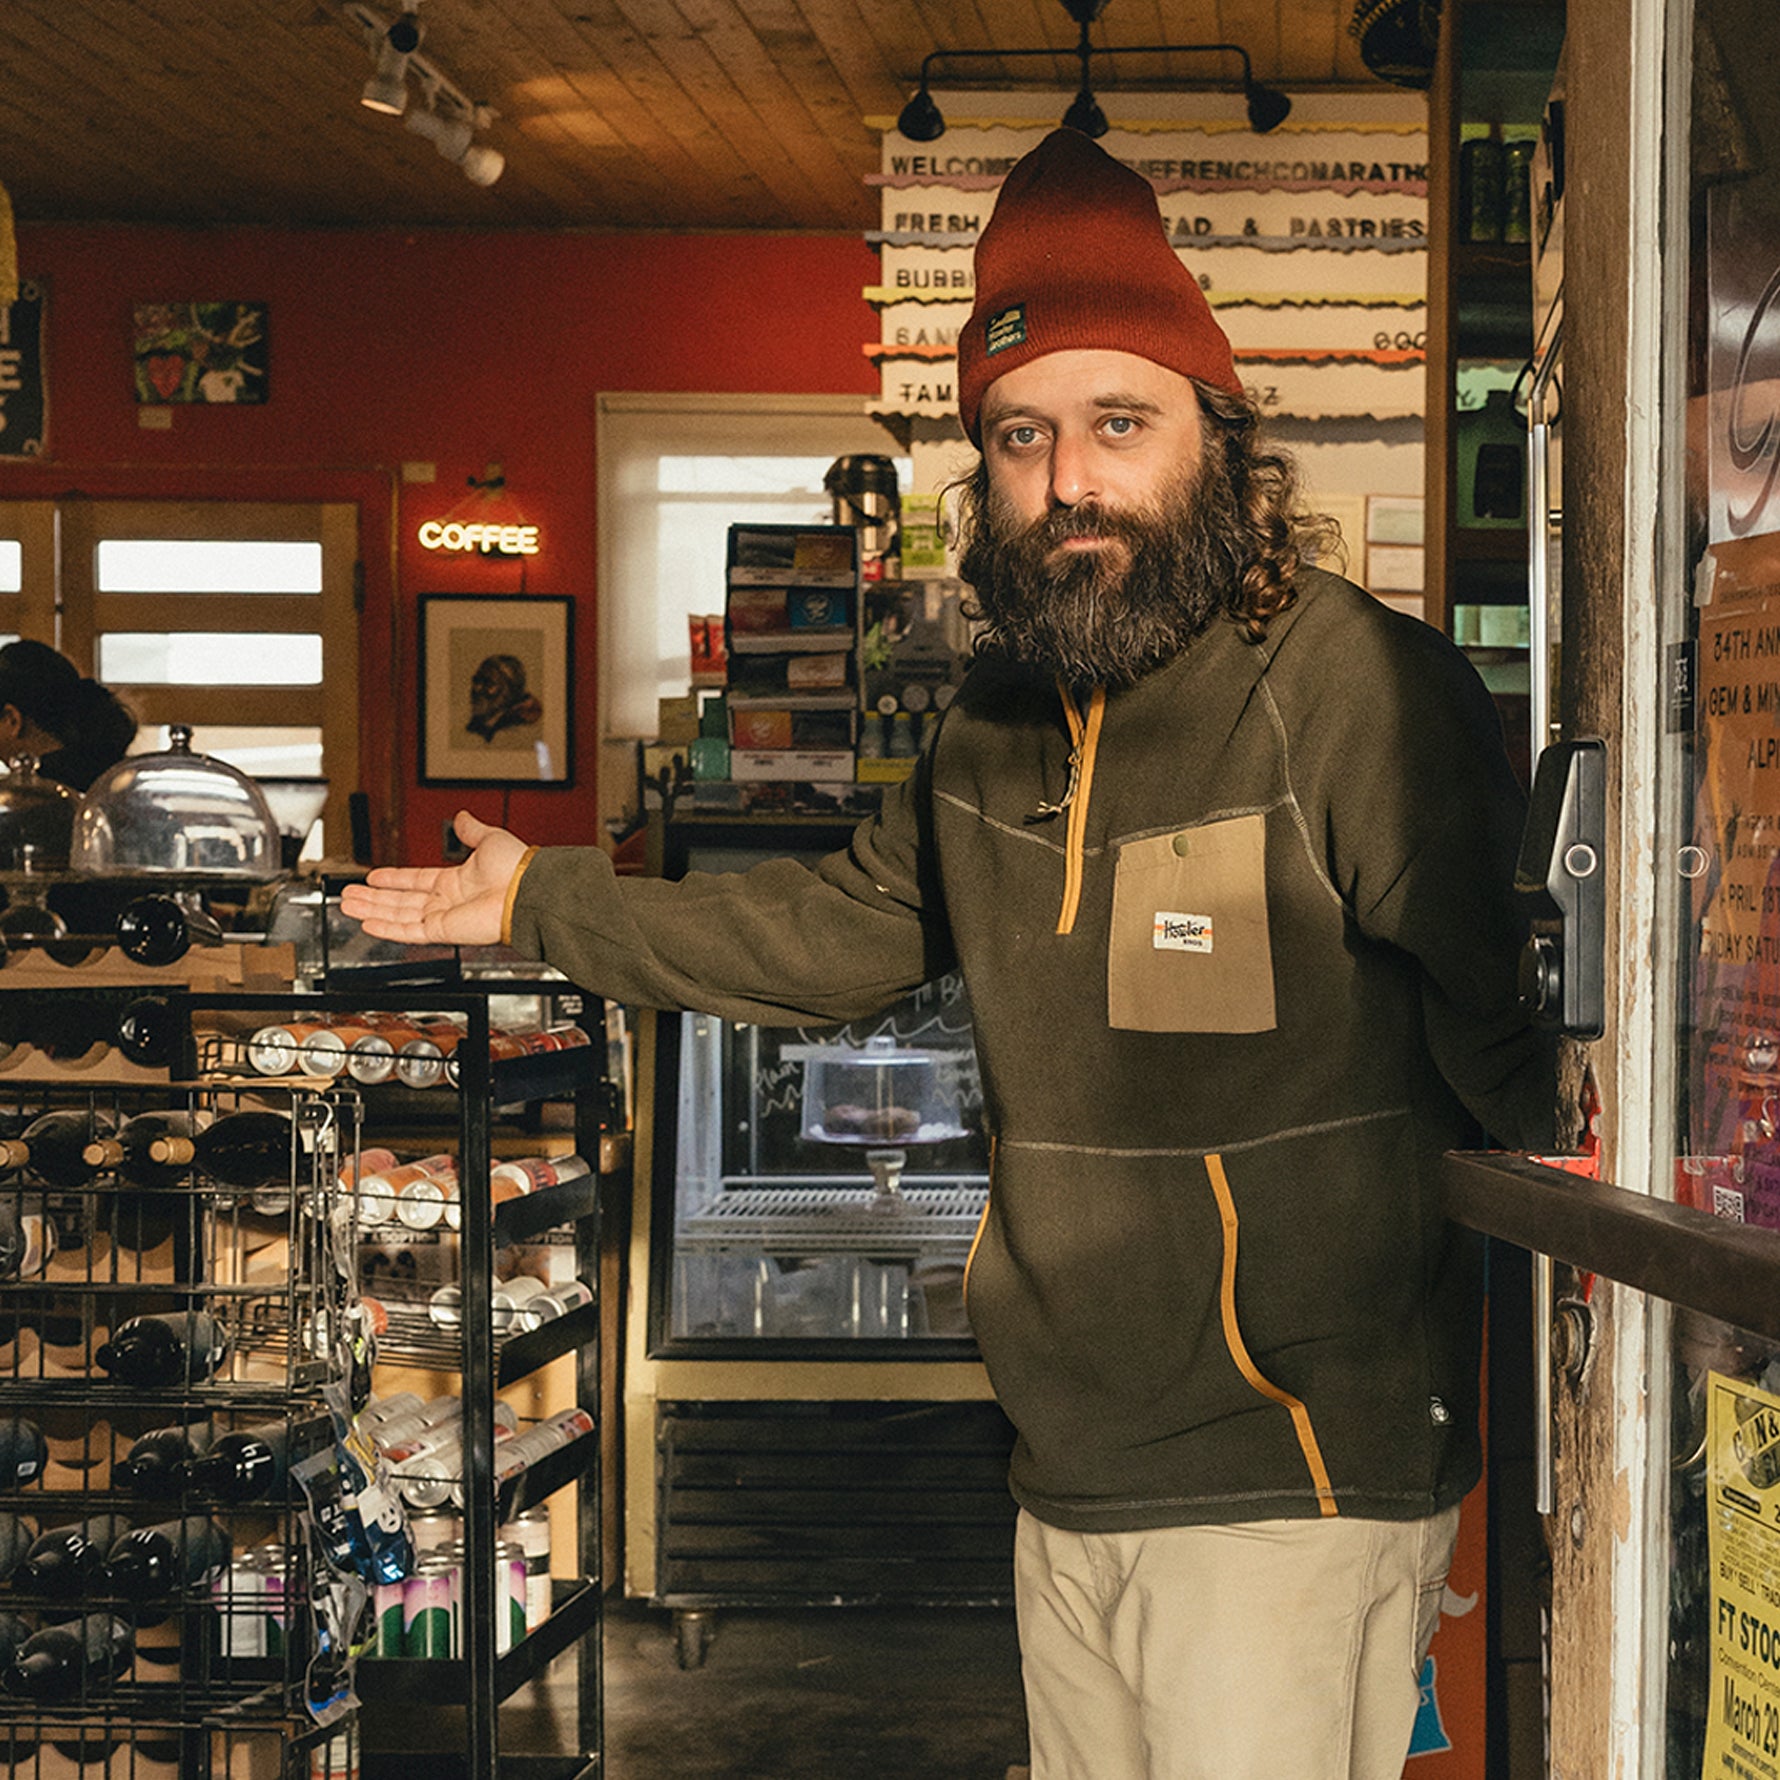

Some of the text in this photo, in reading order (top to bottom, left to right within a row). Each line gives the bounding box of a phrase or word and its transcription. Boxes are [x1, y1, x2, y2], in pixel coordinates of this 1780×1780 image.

[895, 213, 979, 232] FRESH
[1243, 217, 1258, 236] &
[1290, 217, 1425, 238] PASTRIES
[418, 521, 539, 554] COFFEE
[1709, 686, 1738, 716] GEM
[1719, 1597, 1736, 1642] FT
[1723, 1675, 1760, 1747] March
[1763, 1702, 1779, 1758] 29
